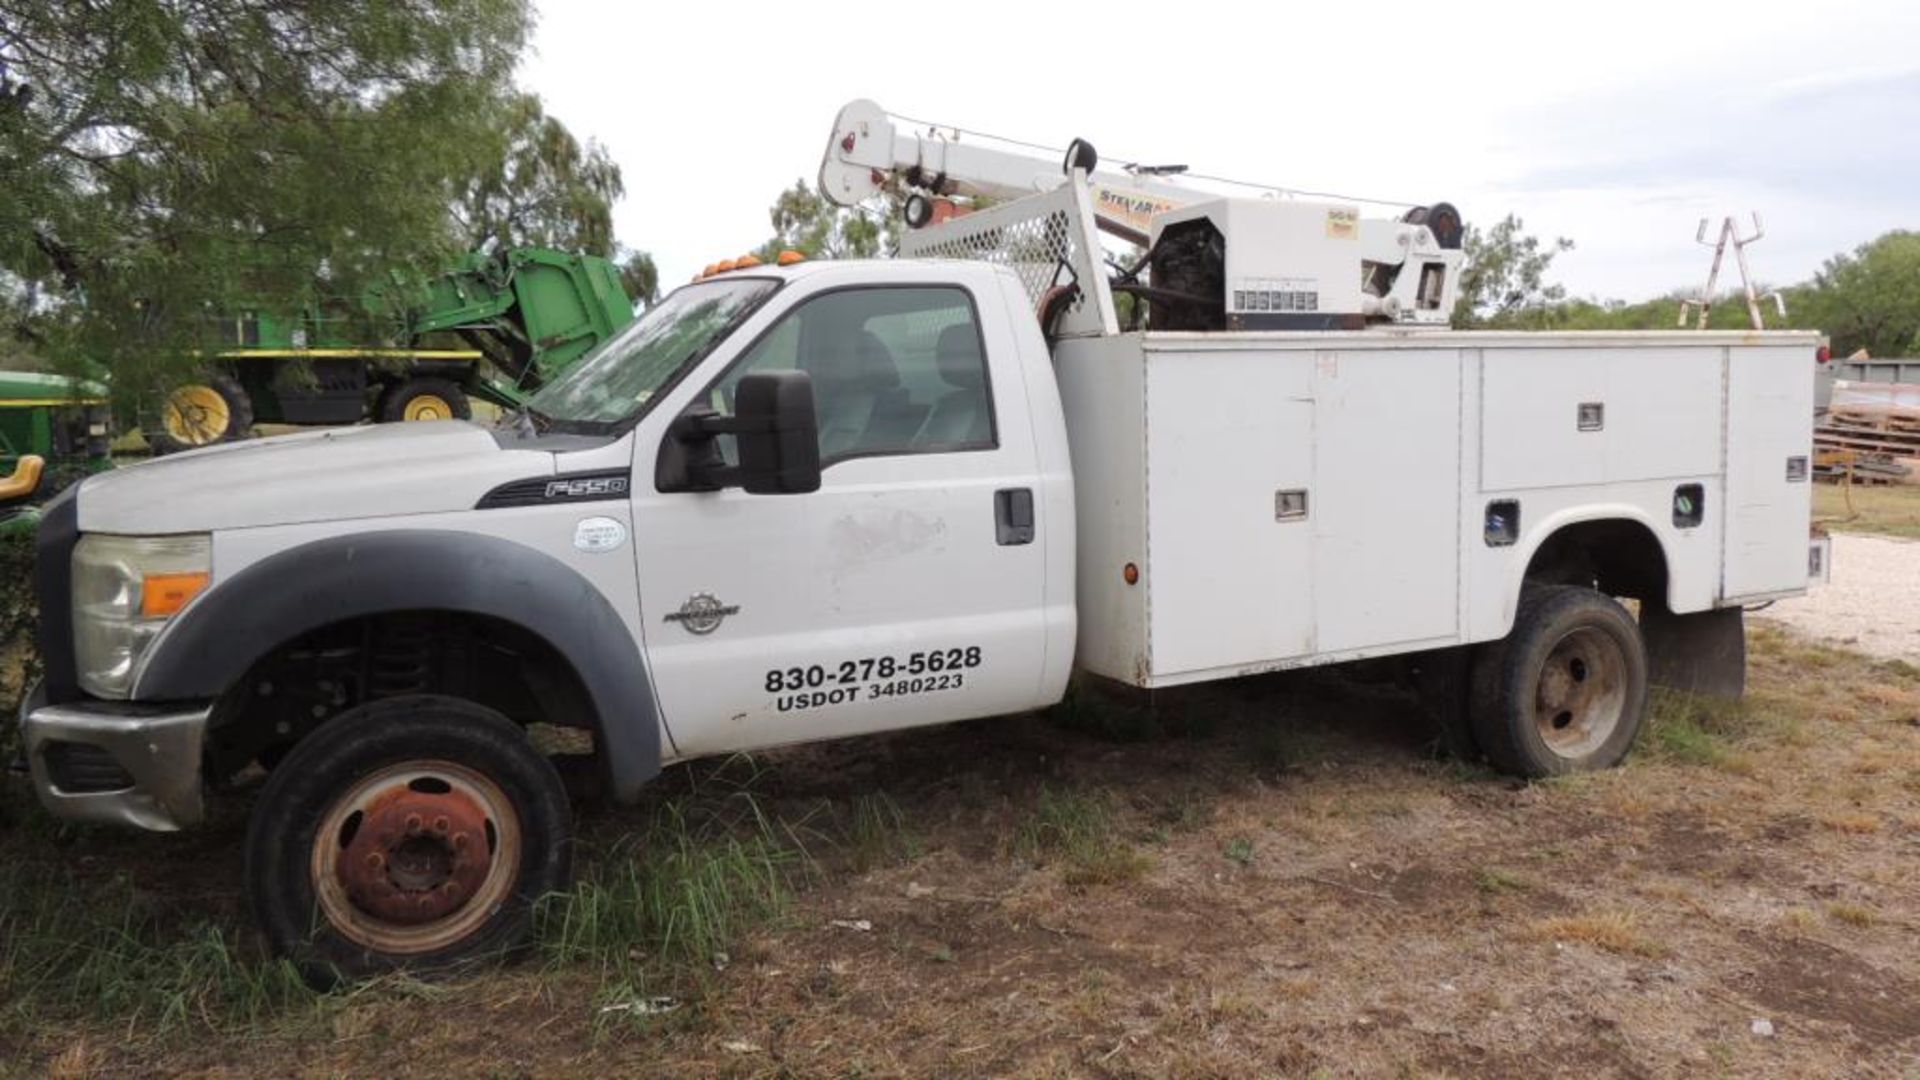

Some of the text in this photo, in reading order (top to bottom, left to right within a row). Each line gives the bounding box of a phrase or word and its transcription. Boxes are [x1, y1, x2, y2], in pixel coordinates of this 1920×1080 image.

[765, 646, 982, 693] 830-278-5628
[777, 674, 963, 712] USDOT 3480223
